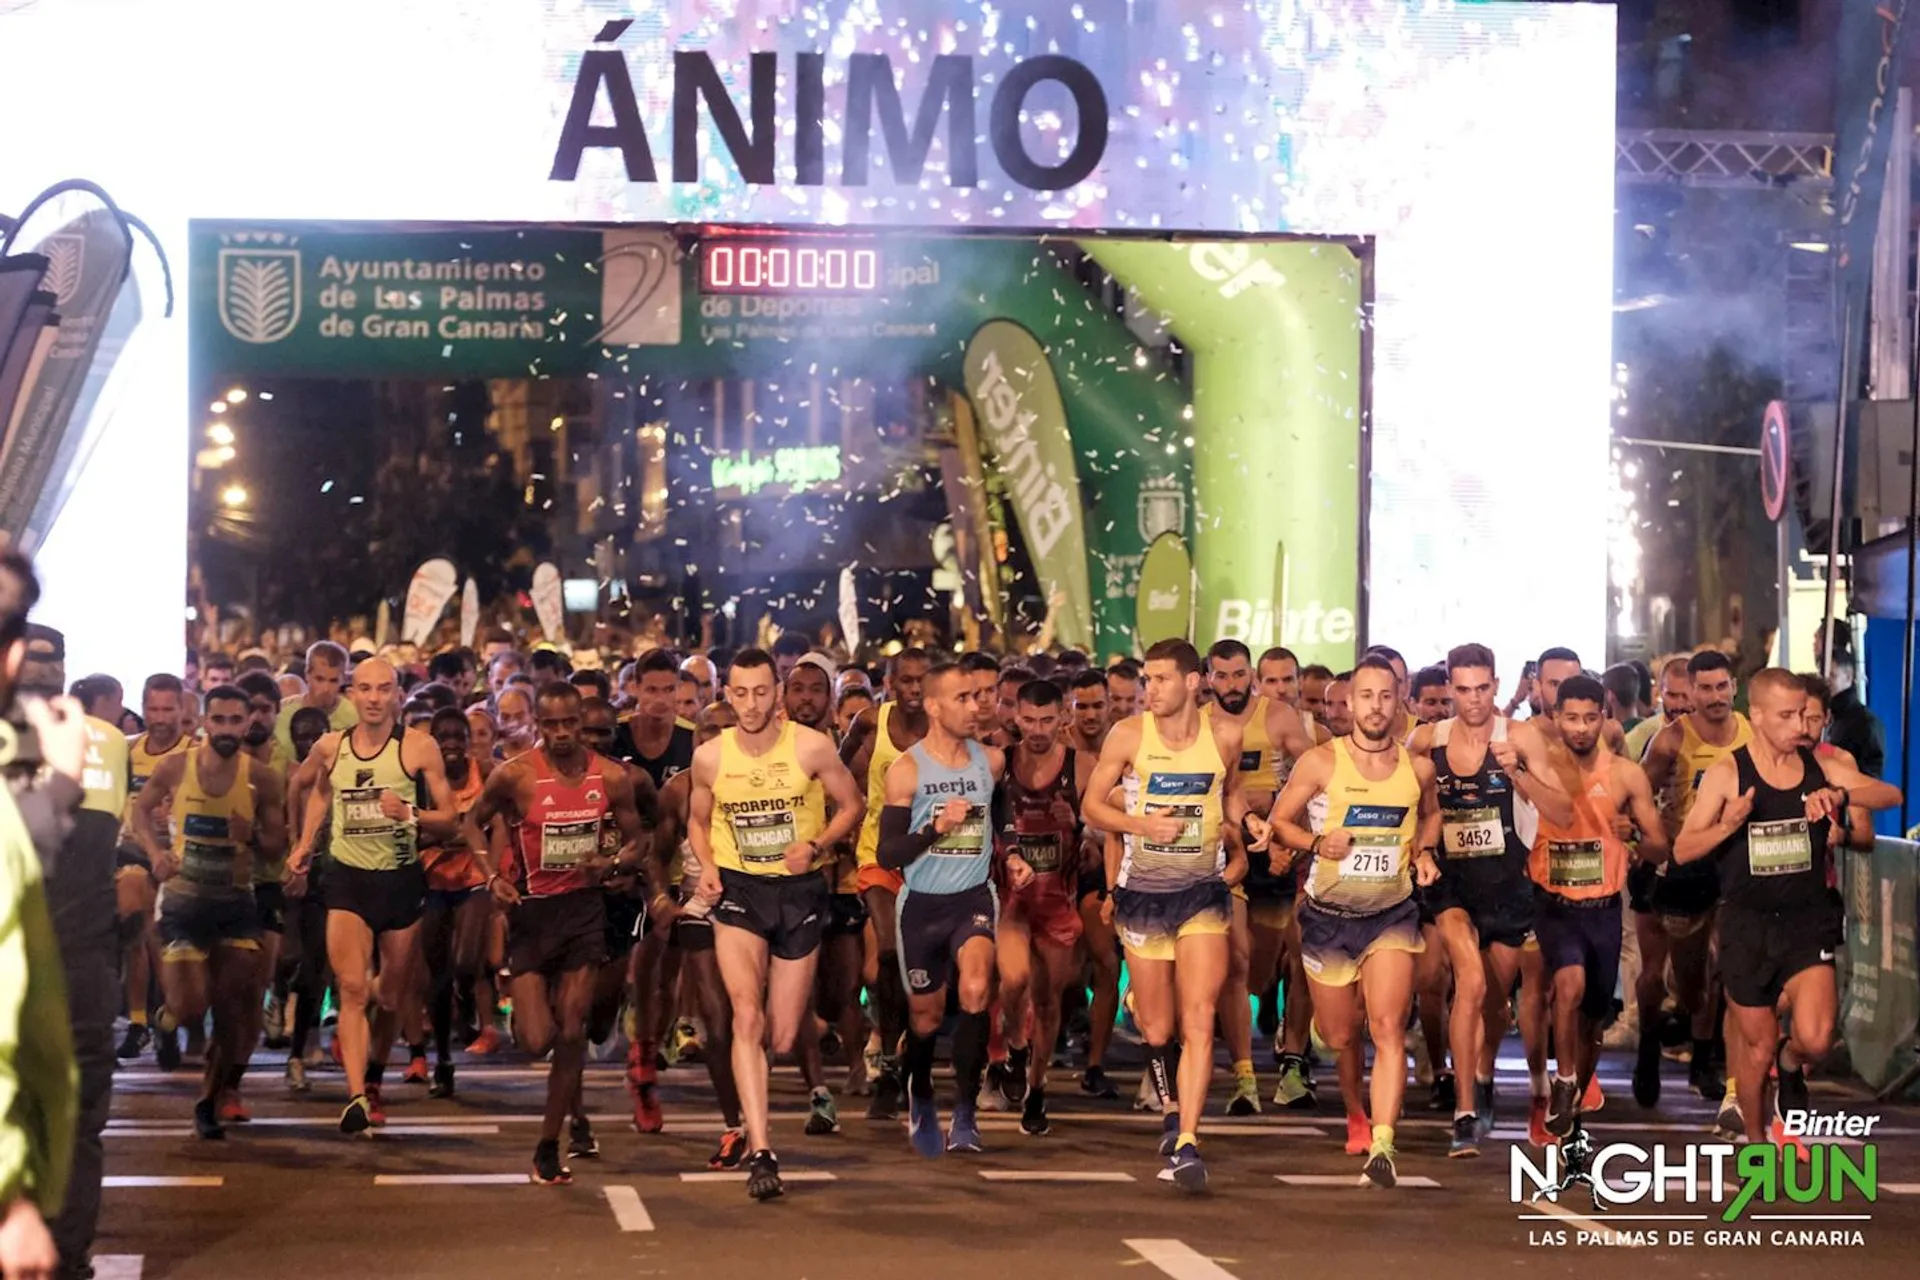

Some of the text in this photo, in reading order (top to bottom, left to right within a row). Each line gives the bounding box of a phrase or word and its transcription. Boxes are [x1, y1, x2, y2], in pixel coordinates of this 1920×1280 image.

[548, 18, 1109, 191] ÁNIMO
[319, 255, 546, 283] Ayuntamiento
[711, 247, 876, 290] 00:00:00
[319, 285, 546, 311] de Las Palmas
[701, 295, 861, 321] de Deportes
[319, 314, 545, 340] de Gran Canaria
[1215, 599, 1357, 646] Binte
[924, 777, 978, 796] nerja
[742, 829, 792, 847] LACHGAR
[1456, 829, 1492, 848] 3452
[1353, 854, 1390, 872] 2715
